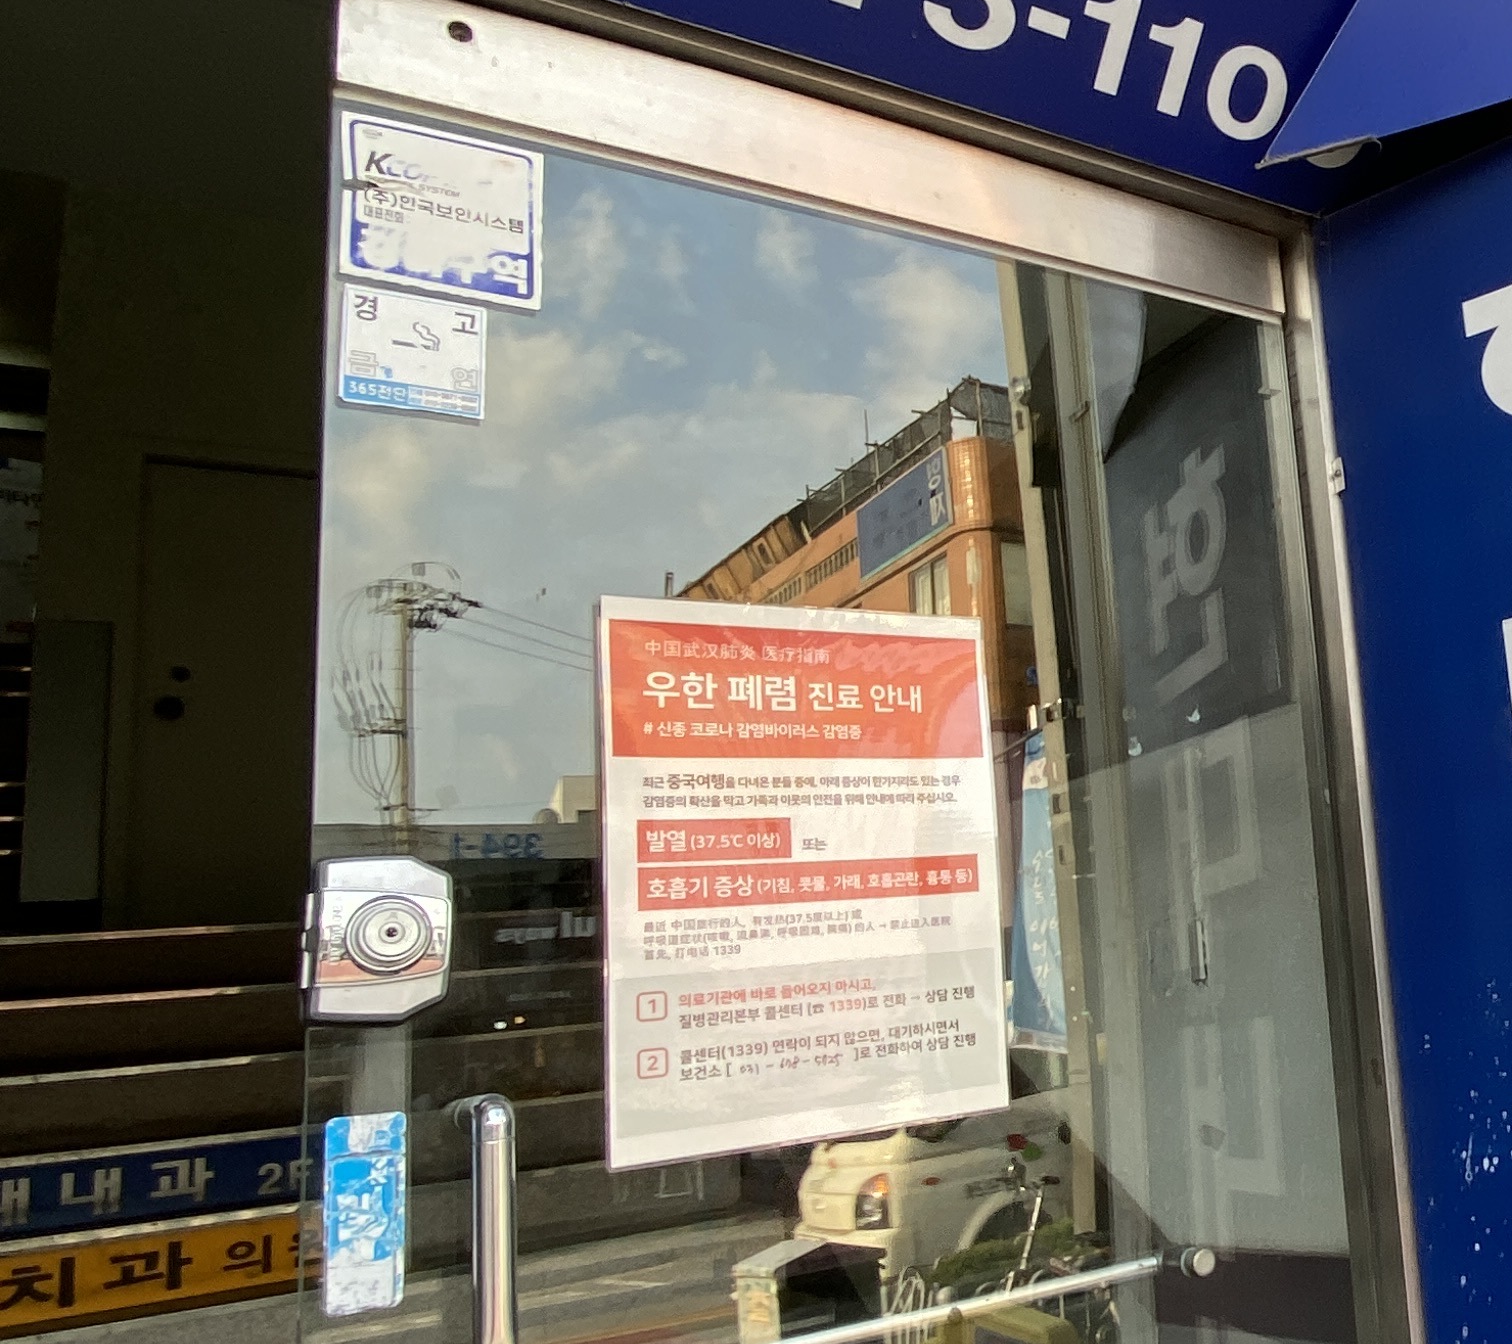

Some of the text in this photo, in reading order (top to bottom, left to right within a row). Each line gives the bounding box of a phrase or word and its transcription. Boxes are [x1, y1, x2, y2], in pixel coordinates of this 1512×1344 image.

[643, 670, 924, 714] 우한 폐렴 진료 안내
[656, 721, 688, 738] 신종
[689, 722, 734, 738] 코로나
[736, 722, 821, 740] 감염바이러스
[646, 829, 688, 853] 발열
[746, 831, 782, 850] 이상)
[801, 837, 828, 851] 또는
[646, 875, 709, 901] 호흡기
[713, 874, 755, 899] 증상
[757, 877, 795, 895] (기침,
[833, 874, 865, 890] 가래,
[678, 977, 877, 1008] 의료기관에 바로 들어오지 마시고,
[679, 1007, 761, 1030] 질병관리본부
[764, 1002, 804, 1021] 콜센터
[882, 992, 907, 1009] 전화
[924, 988, 949, 1004] 상담
[952, 985, 976, 1001] 진행
[772, 1035, 812, 1055] 연락이
[815, 1033, 840, 1049] 되지
[844, 1027, 885, 1046] 않으면,
[888, 1018, 960, 1041] 대기하시면서
[875, 1039, 923, 1059] 전화하여
[926, 1035, 950, 1052] 상담
[953, 1032, 977, 1049] 진행
[679, 1062, 722, 1082] 보건소
[258, 1158, 314, 1195] 2F
